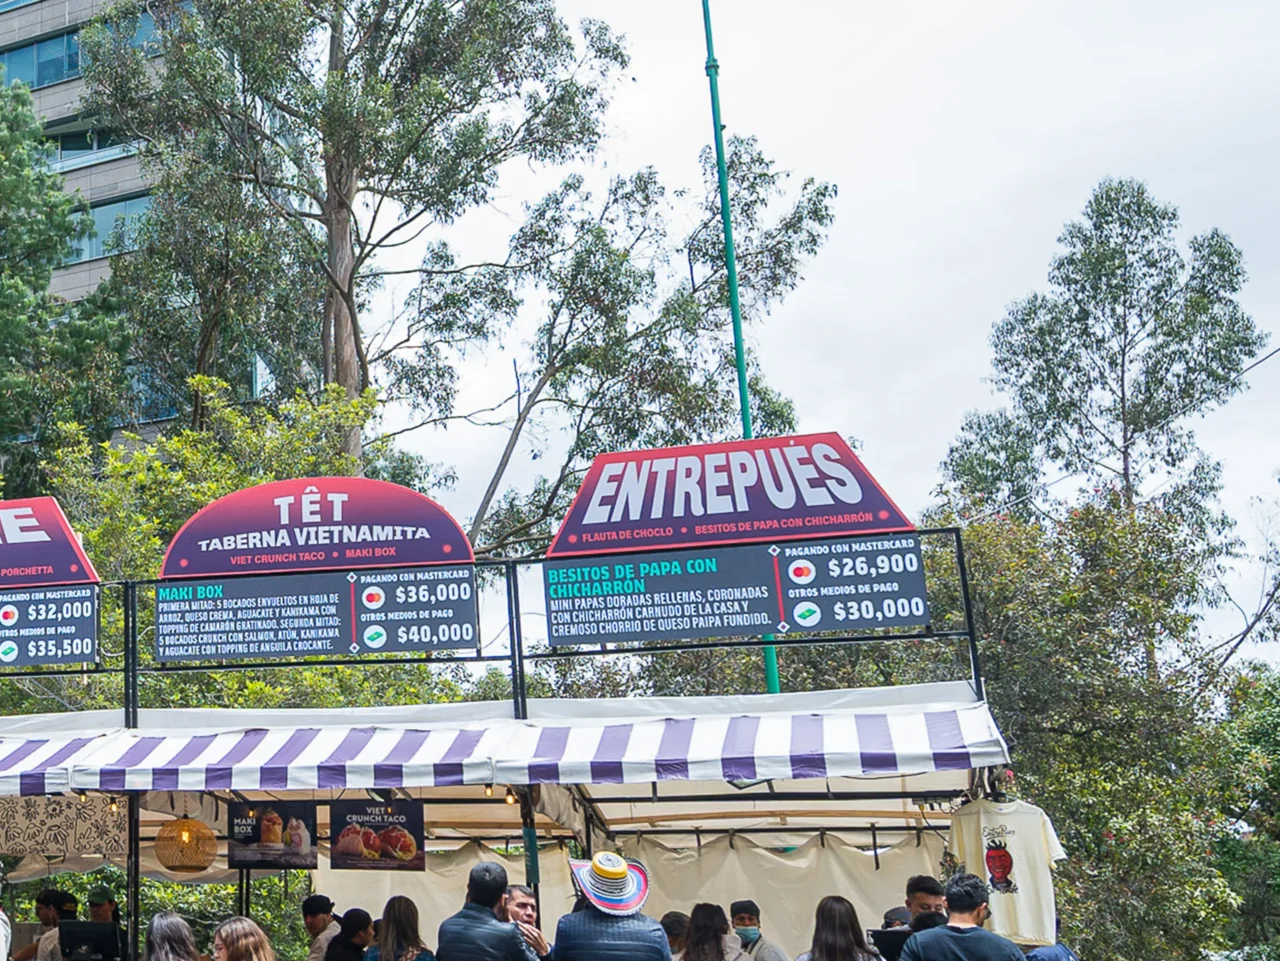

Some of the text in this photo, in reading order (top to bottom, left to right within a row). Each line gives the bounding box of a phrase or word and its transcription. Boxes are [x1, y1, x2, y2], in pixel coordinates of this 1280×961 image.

[582, 440, 862, 525] ENTREPUÉS
[274, 486, 348, 525] TÊT
[695, 512, 872, 534] BESITOS DE PAPA CON CHICHARRÓN
[198, 525, 430, 551] TABERNA VIETNAMITA
[582, 528, 673, 542] FLAUTA DE CHOCLO
[346, 548, 396, 558] MAKI BOX
[785, 539, 914, 556] PAGANDO CON MASTERCARD
[230, 552, 325, 565] VIET CRUNCH TACO
[828, 553, 918, 578] $26,900
[1, 566, 53, 577] PORCHETTA
[361, 570, 469, 583] PAGANDO CON MASTERCARD
[549, 559, 717, 583] BESITOS DE PAPA CON
[0, 593, 30, 602] PAGANDO
[46, 590, 91, 599] MASTERCARD
[159, 584, 223, 600] MAKI BOX
[396, 583, 470, 604] $36,000
[549, 578, 645, 598] CHICHARRÓN
[788, 583, 898, 598] OTROS MEDIOS DE PAGO
[159, 594, 339, 611] PRIMERA MITAD: 5 BOCADOS ENVUELTOS EN HOJA DE
[551, 586, 768, 611] MINI PAPAS DORADAS RELLENAS, CORONADAS
[28, 601, 91, 621] $32,000
[361, 613, 386, 621] OTROS
[388, 611, 417, 620] MEDIOS
[432, 610, 453, 618] PAGO
[552, 601, 749, 623] CON CHICHARRÓN CARNUDO DE LA CASA Y
[834, 597, 924, 621] $30,000
[20, 628, 45, 636] MEDIOS
[58, 626, 75, 634] PAGO
[398, 623, 473, 644] $40,000
[552, 613, 771, 636] CREMOSO CHORRIO DE QUESO PAIPA FUNDIDO.
[28, 638, 91, 658] $35,500
